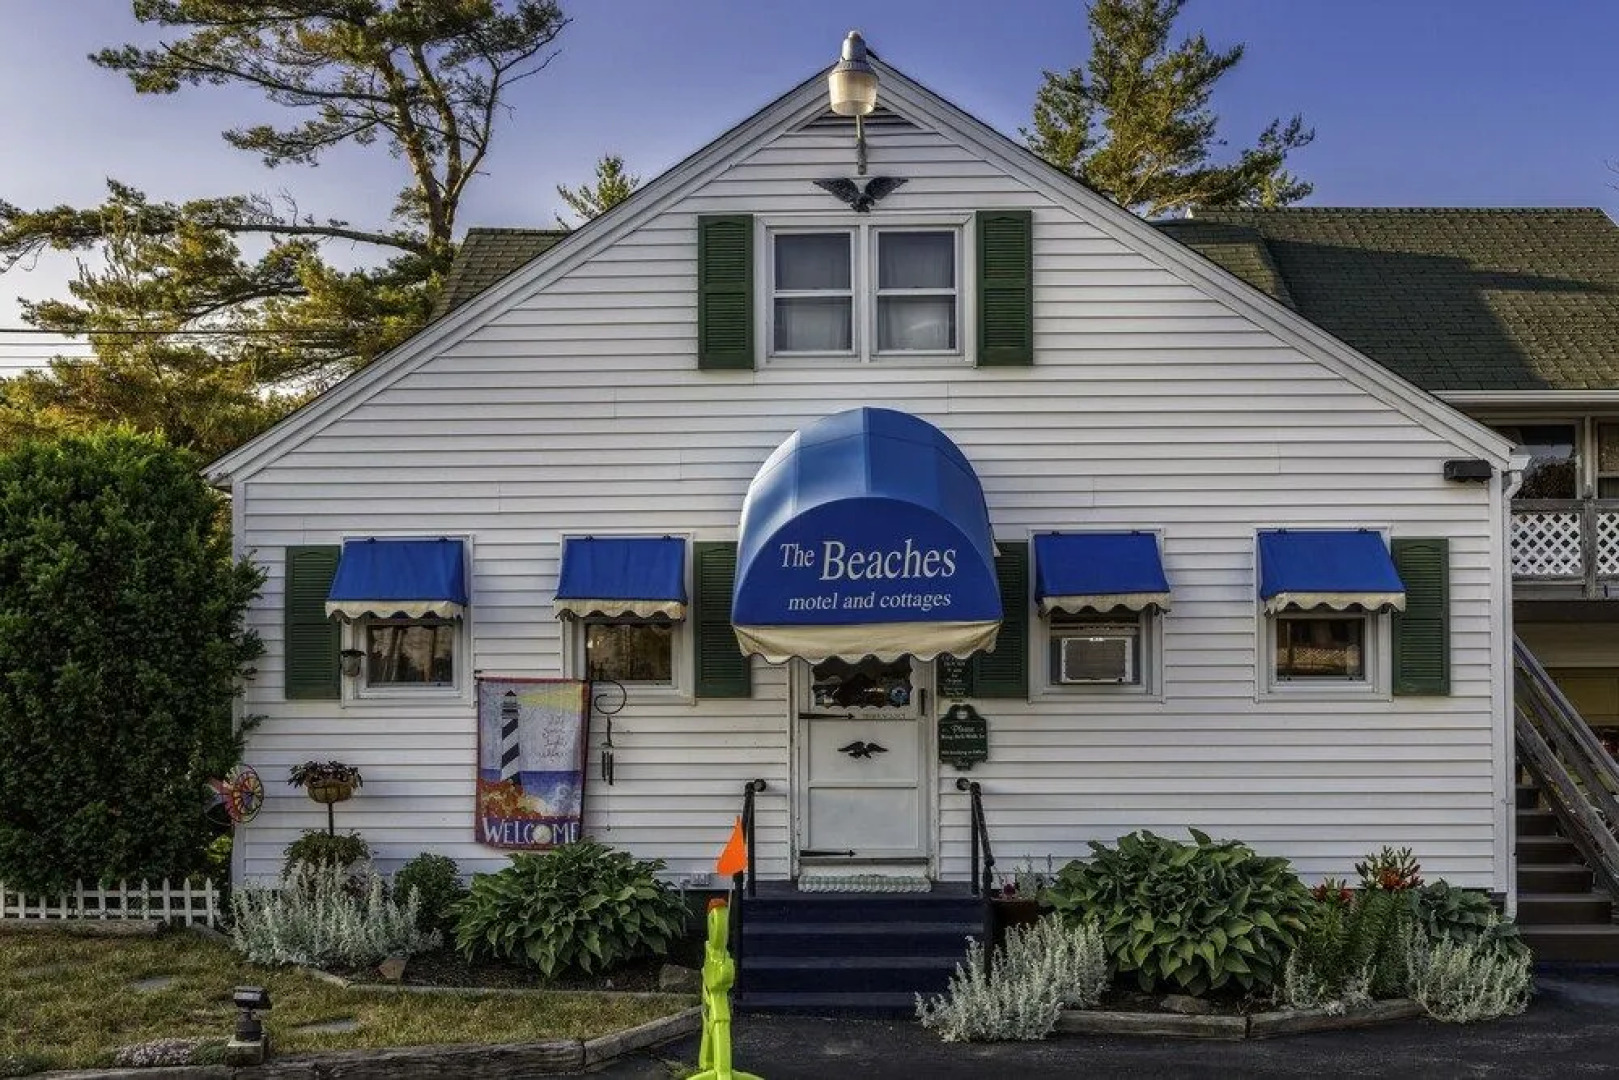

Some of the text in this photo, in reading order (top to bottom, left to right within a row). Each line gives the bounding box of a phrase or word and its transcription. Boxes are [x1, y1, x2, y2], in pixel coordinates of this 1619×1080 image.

[780, 538, 957, 581] The Beaches
[788, 591, 952, 612] motel and cottages
[482, 817, 580, 844] WELCOME
